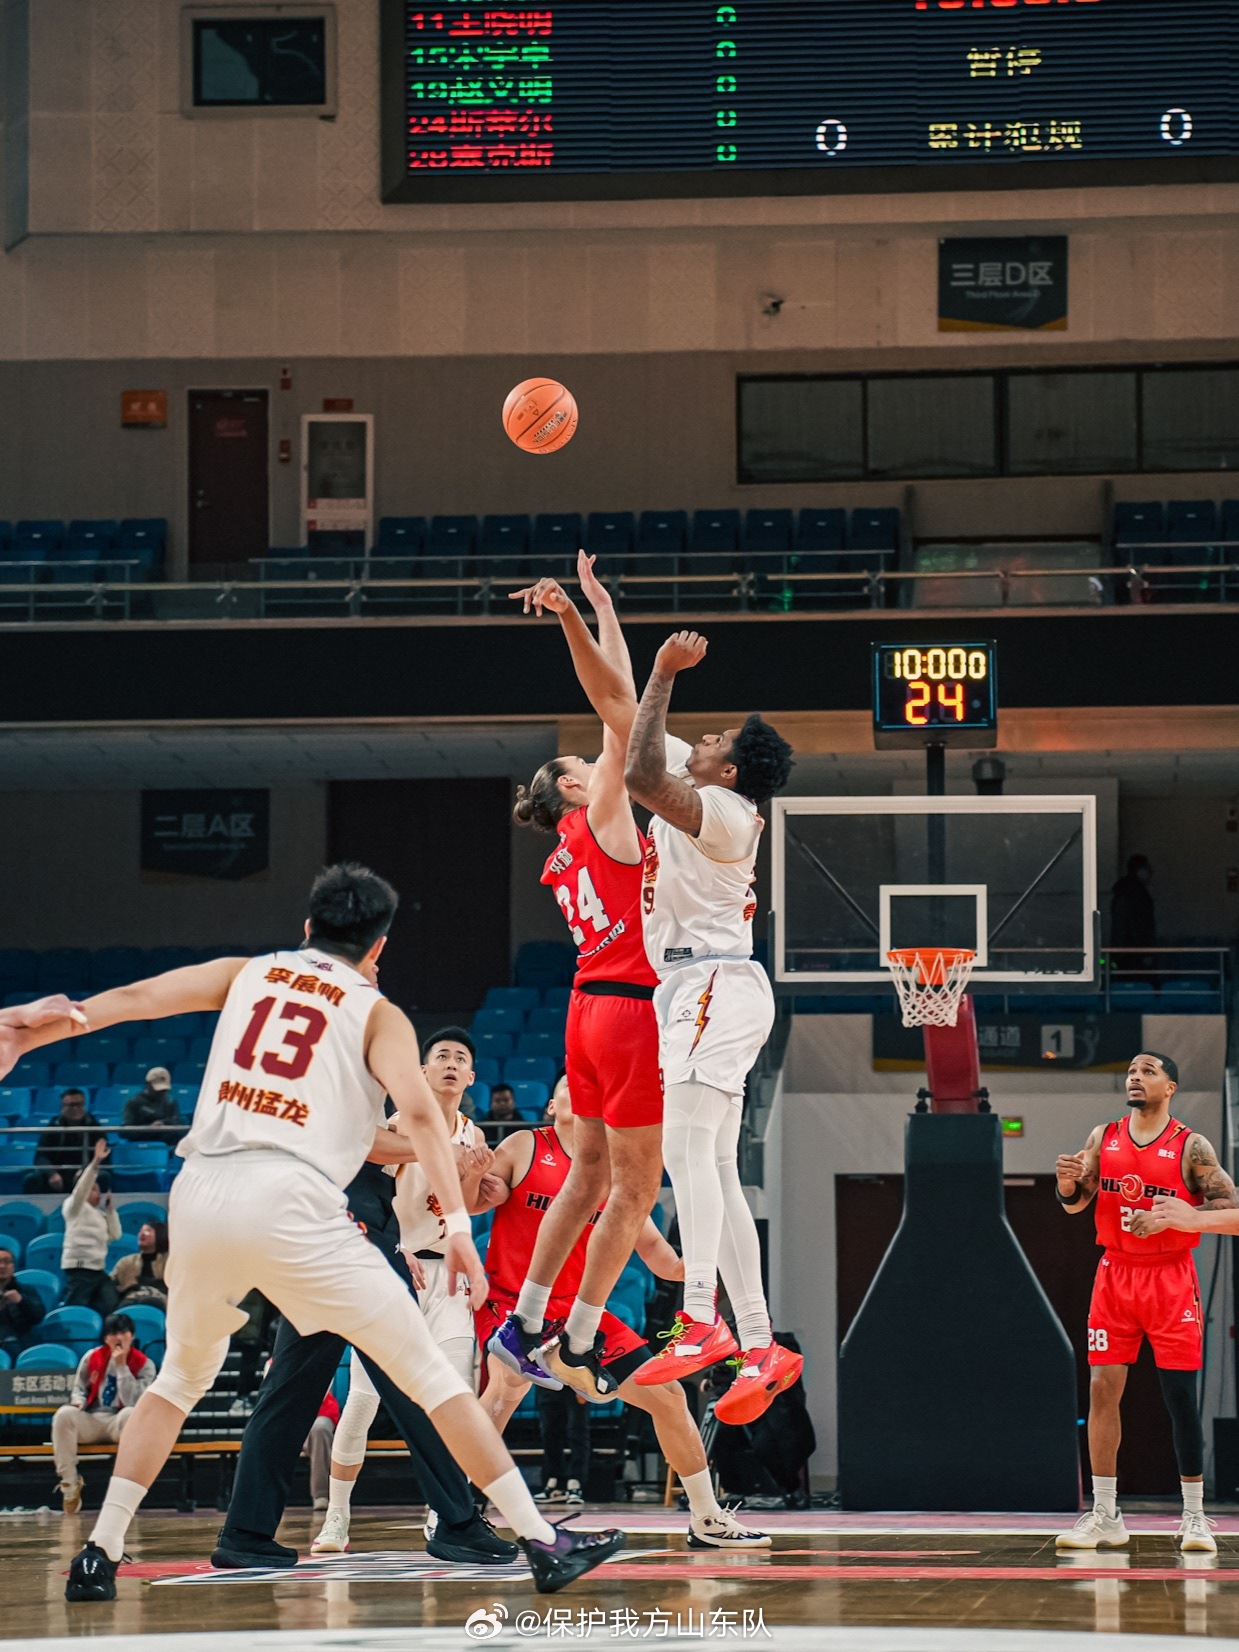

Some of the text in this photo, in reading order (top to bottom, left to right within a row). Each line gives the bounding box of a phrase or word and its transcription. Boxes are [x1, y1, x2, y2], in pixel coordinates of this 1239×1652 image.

[815, 118, 848, 156] 0
[928, 120, 1083, 152] 累计犯规
[1160, 107, 1193, 146] 0
[950, 261, 1054, 287] 三层D区
[905, 682, 964, 725] 24
[153, 813, 256, 838] 二层A区
[556, 866, 611, 946] 24
[233, 995, 328, 1081] 13
[979, 1025, 1021, 1047] 通道
[1087, 1328, 1109, 1352] 28
